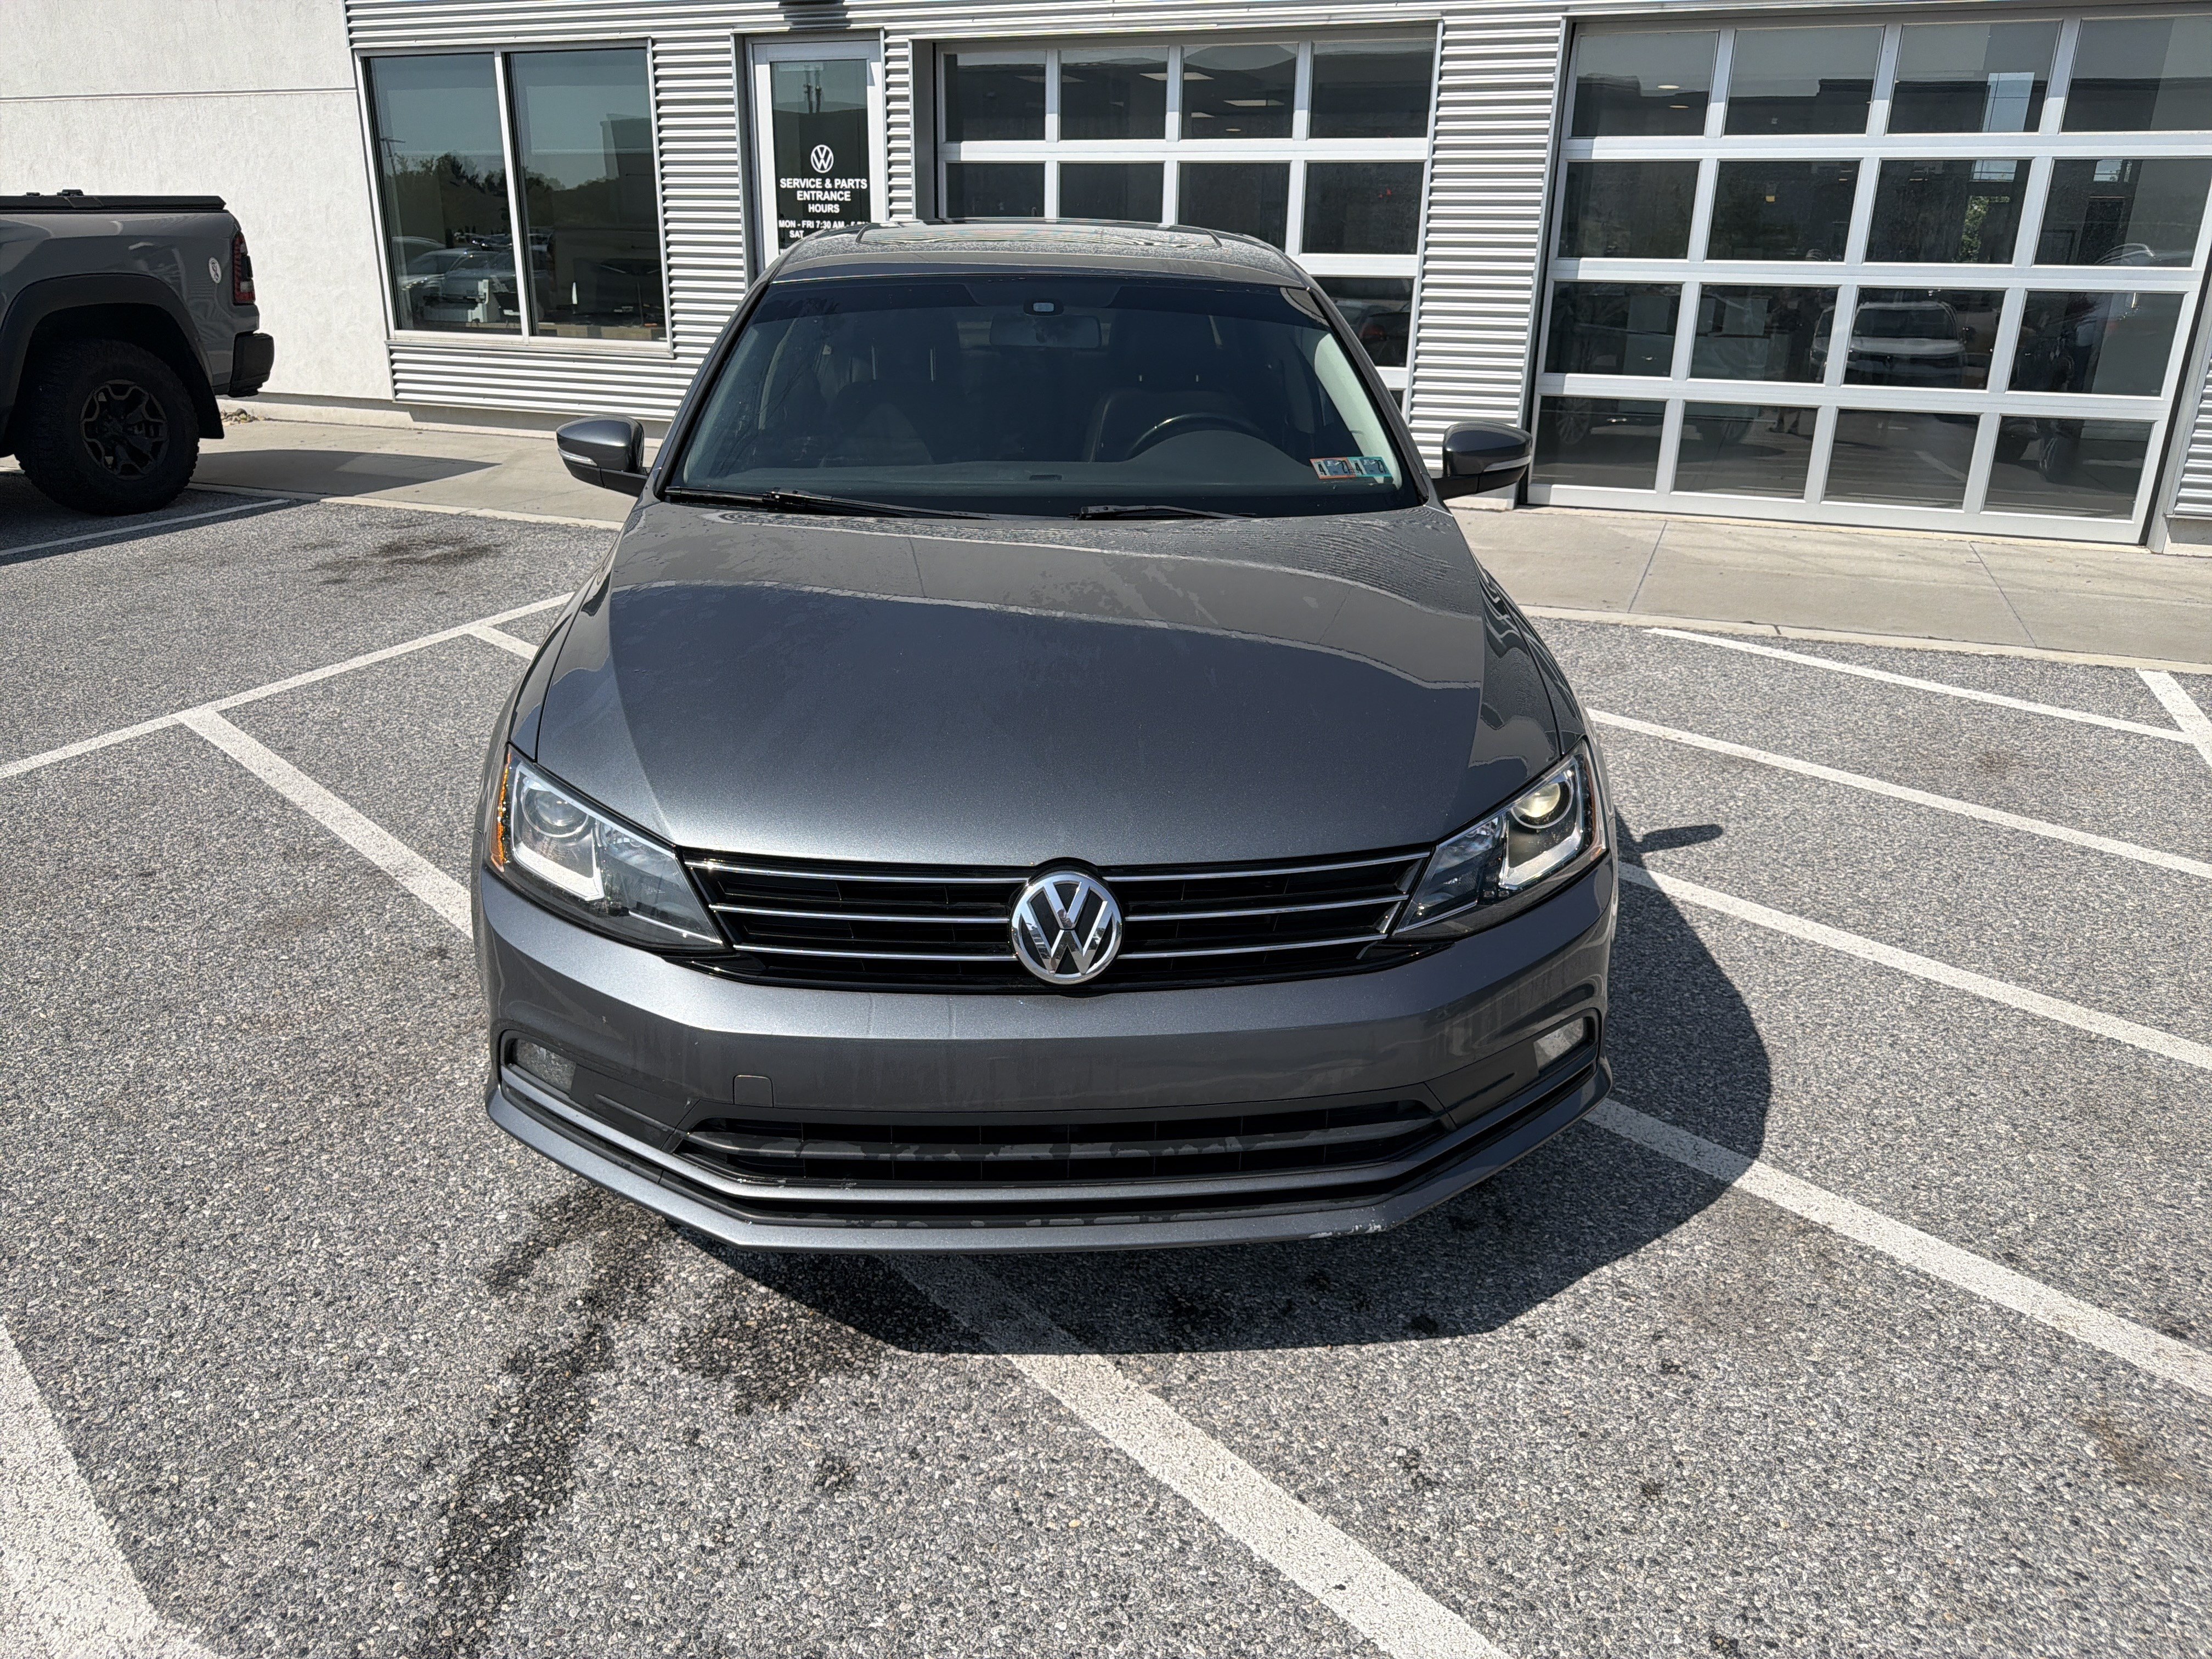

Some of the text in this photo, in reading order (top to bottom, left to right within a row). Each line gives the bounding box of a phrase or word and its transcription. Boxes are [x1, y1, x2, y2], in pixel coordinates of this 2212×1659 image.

[811, 144, 834, 173] VW
[780, 178, 867, 189] SERVICE & PARTS
[797, 190, 851, 201] ENTRANCE
[808, 204, 840, 213] HOURS
[778, 219, 796, 228] MON
[802, 220, 815, 229] FRI
[816, 220, 832, 229] 7:30
[832, 221, 845, 229] AM
[789, 229, 805, 239] SAT
[1012, 871, 1122, 985] VW
